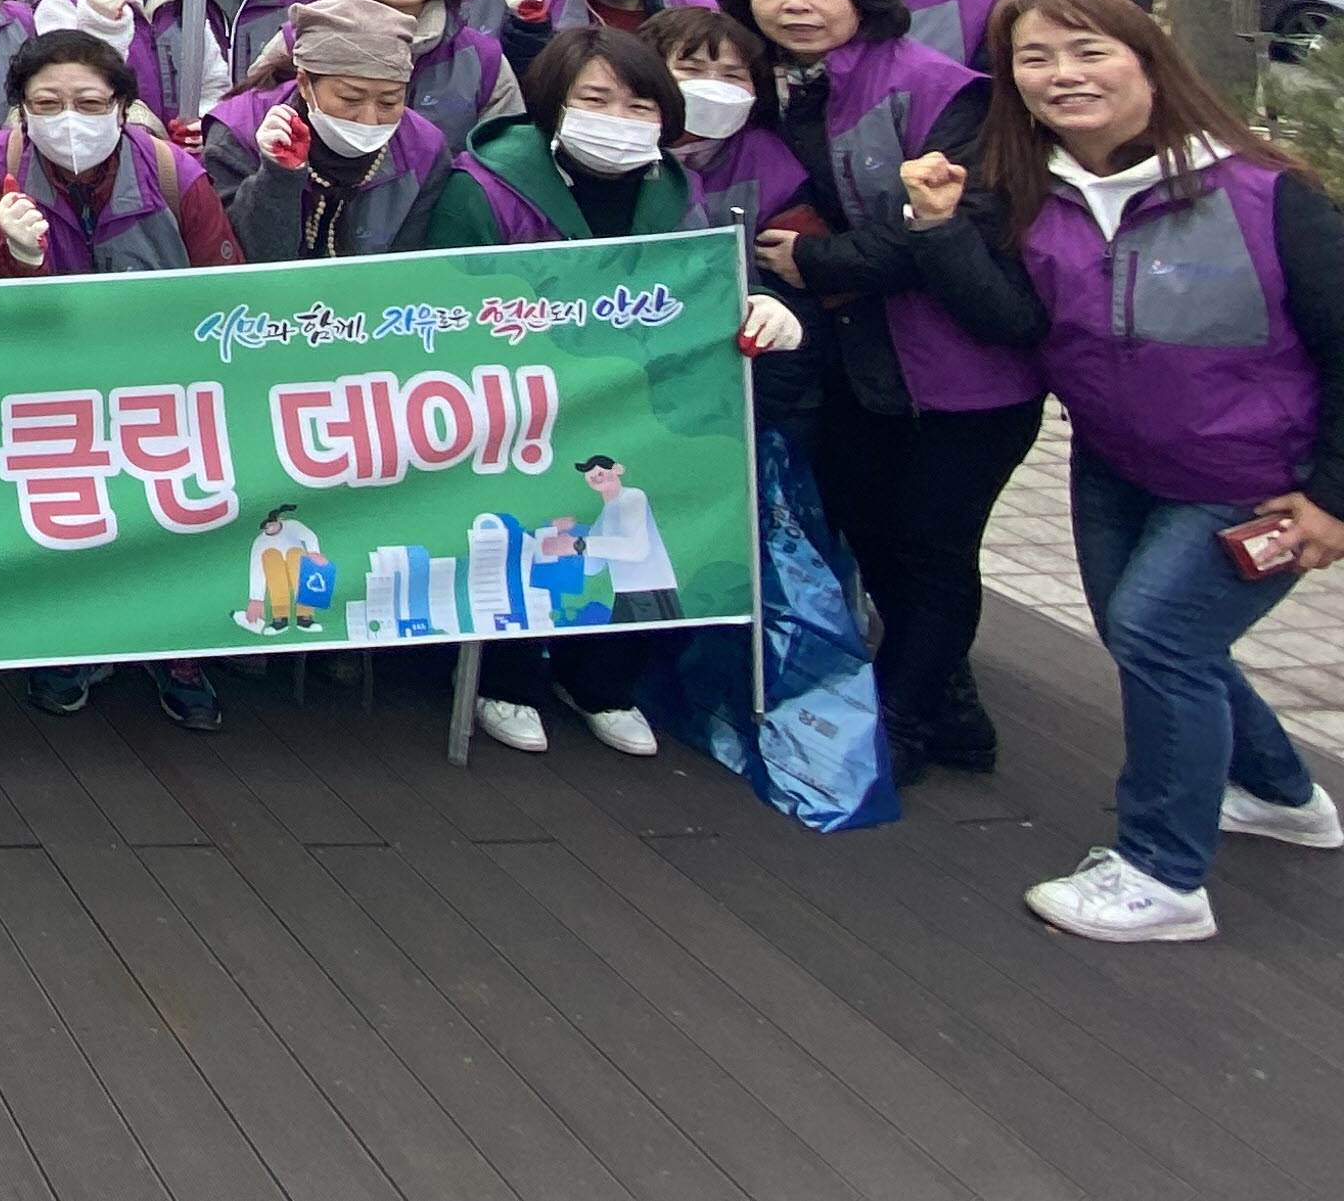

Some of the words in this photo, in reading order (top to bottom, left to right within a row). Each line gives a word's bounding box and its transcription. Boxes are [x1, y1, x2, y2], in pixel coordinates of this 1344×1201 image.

[196, 305, 296, 361] 시민과
[375, 303, 469, 352] 자유로운
[477, 296, 584, 344] 혁신도시
[593, 283, 682, 327] 안산
[5, 388, 231, 541] 클린
[276, 373, 551, 482] 데이!
